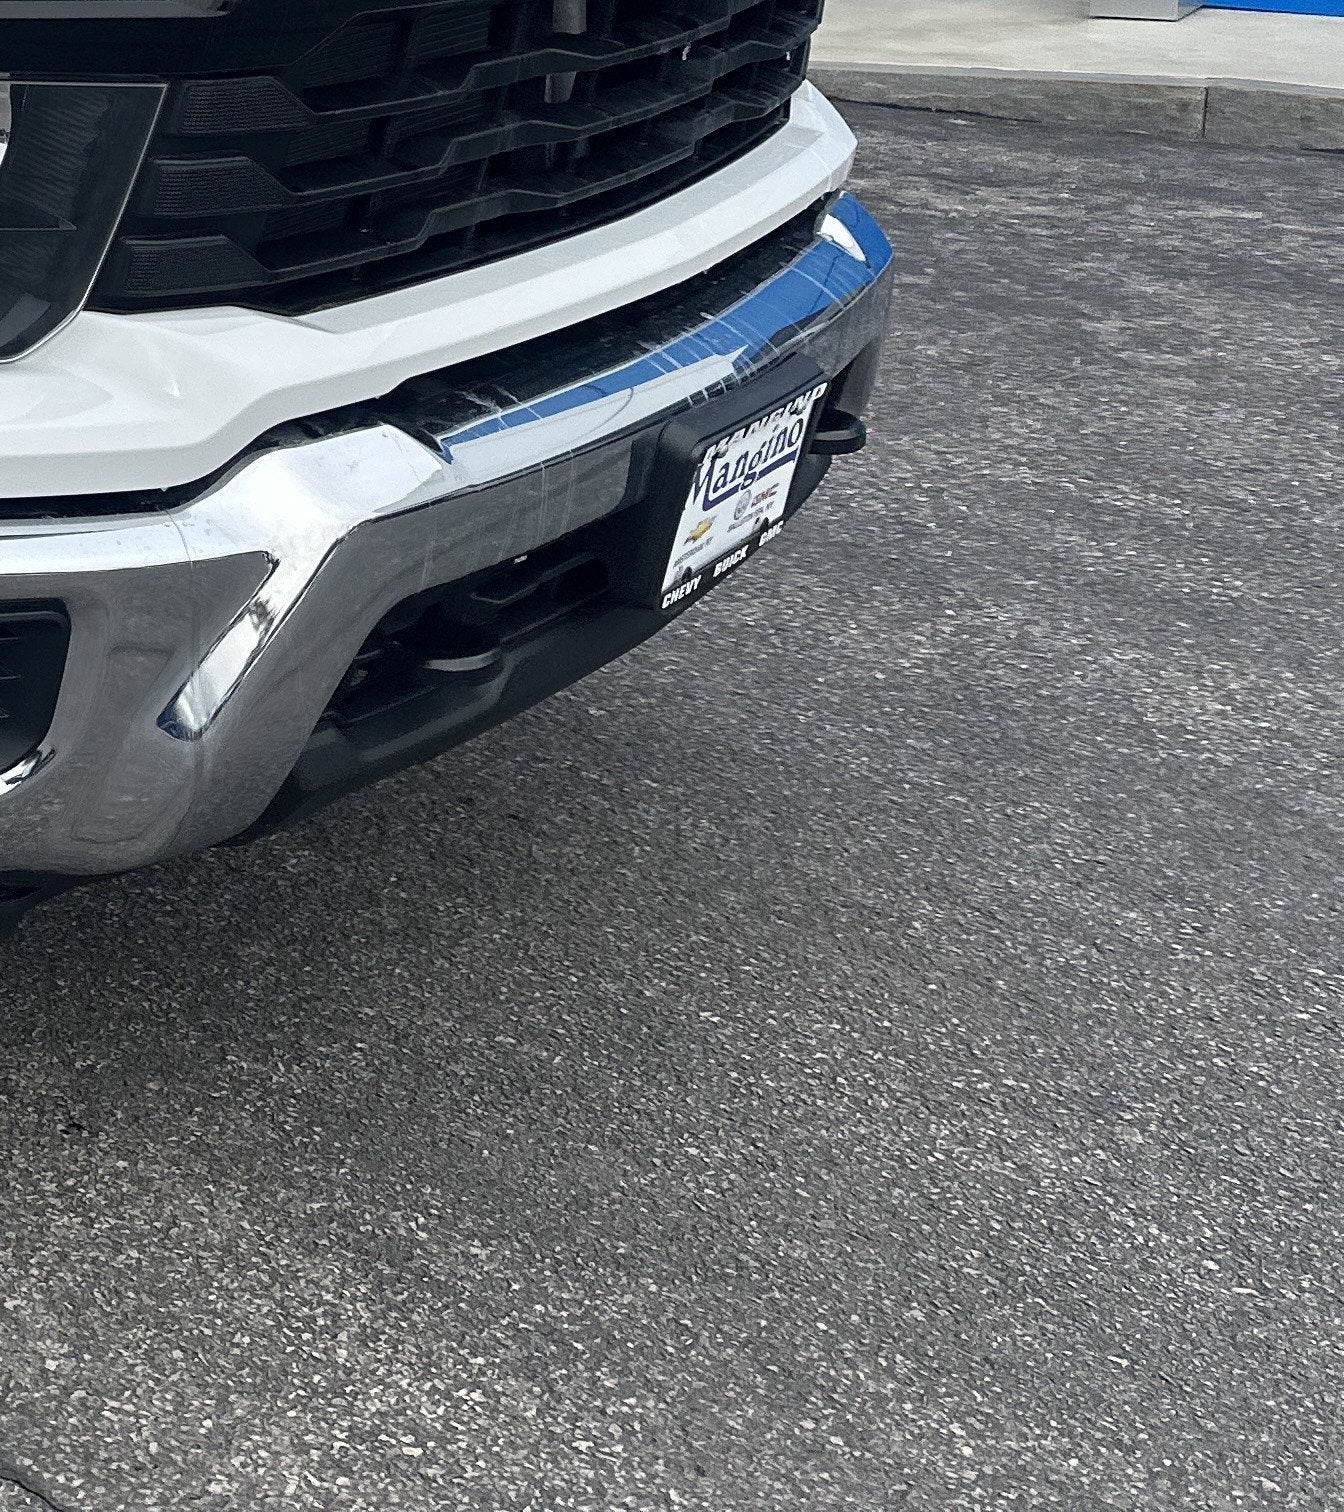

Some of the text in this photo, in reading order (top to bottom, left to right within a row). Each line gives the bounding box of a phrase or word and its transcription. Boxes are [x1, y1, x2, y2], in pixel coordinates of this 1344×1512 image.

[692, 417, 804, 510] Mangino
[661, 575, 702, 609] CHEVY
[712, 544, 749, 577] BUICK
[758, 520, 784, 547] GMC
